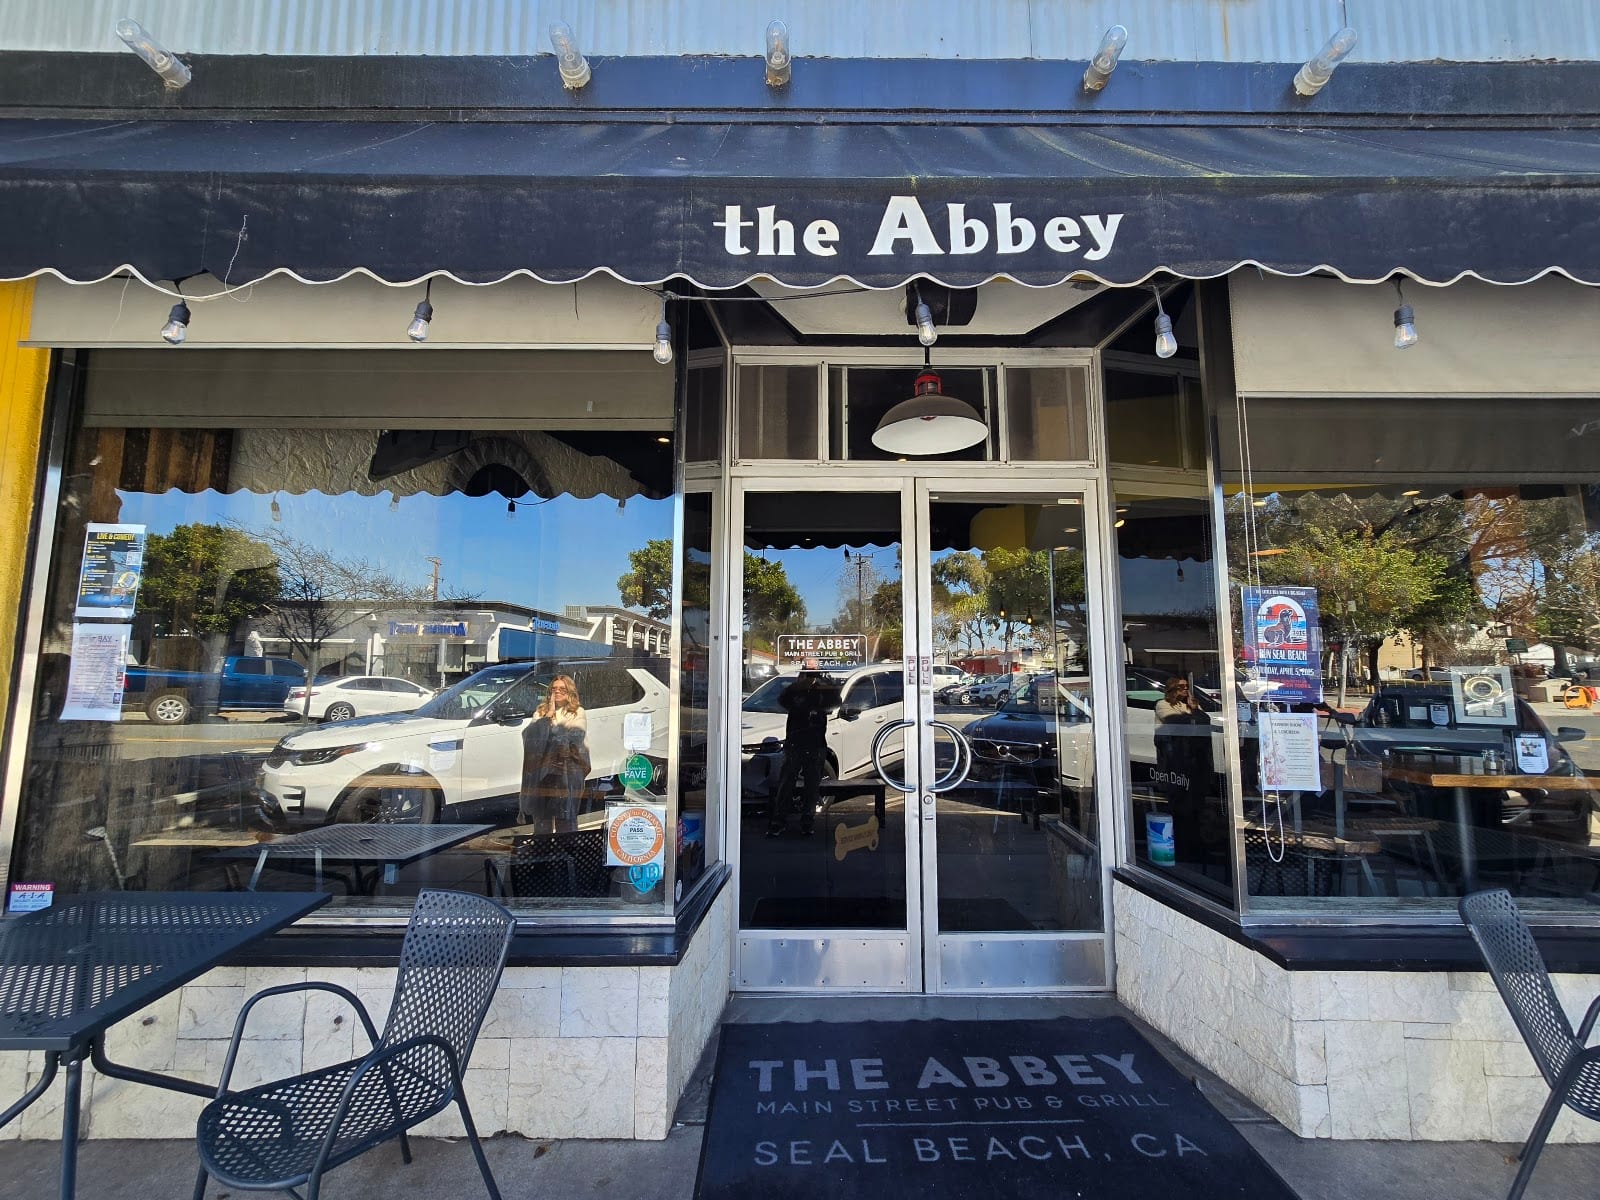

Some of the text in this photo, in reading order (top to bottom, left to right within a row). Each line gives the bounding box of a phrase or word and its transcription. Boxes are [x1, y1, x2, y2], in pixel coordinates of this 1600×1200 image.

[712, 195, 1125, 261] the Abbey
[788, 639, 859, 650] THE ABBEY
[1259, 649, 1307, 661] RUN SEAL BEACH
[908, 659, 916, 685] PULL
[921, 659, 930, 685] PULL
[1280, 667, 1294, 675] APRIL
[624, 770, 647, 779] FAVE
[1149, 767, 1190, 791] Open Daily
[641, 810, 663, 838] ORANGE
[616, 850, 657, 863] CALIFORNIA
[749, 1053, 1146, 1093] THE ABBEY
[756, 1093, 1171, 1115] MAIN STREET PUB & GRILL
[753, 1131, 1209, 1166] SEAL BEACH, CA
